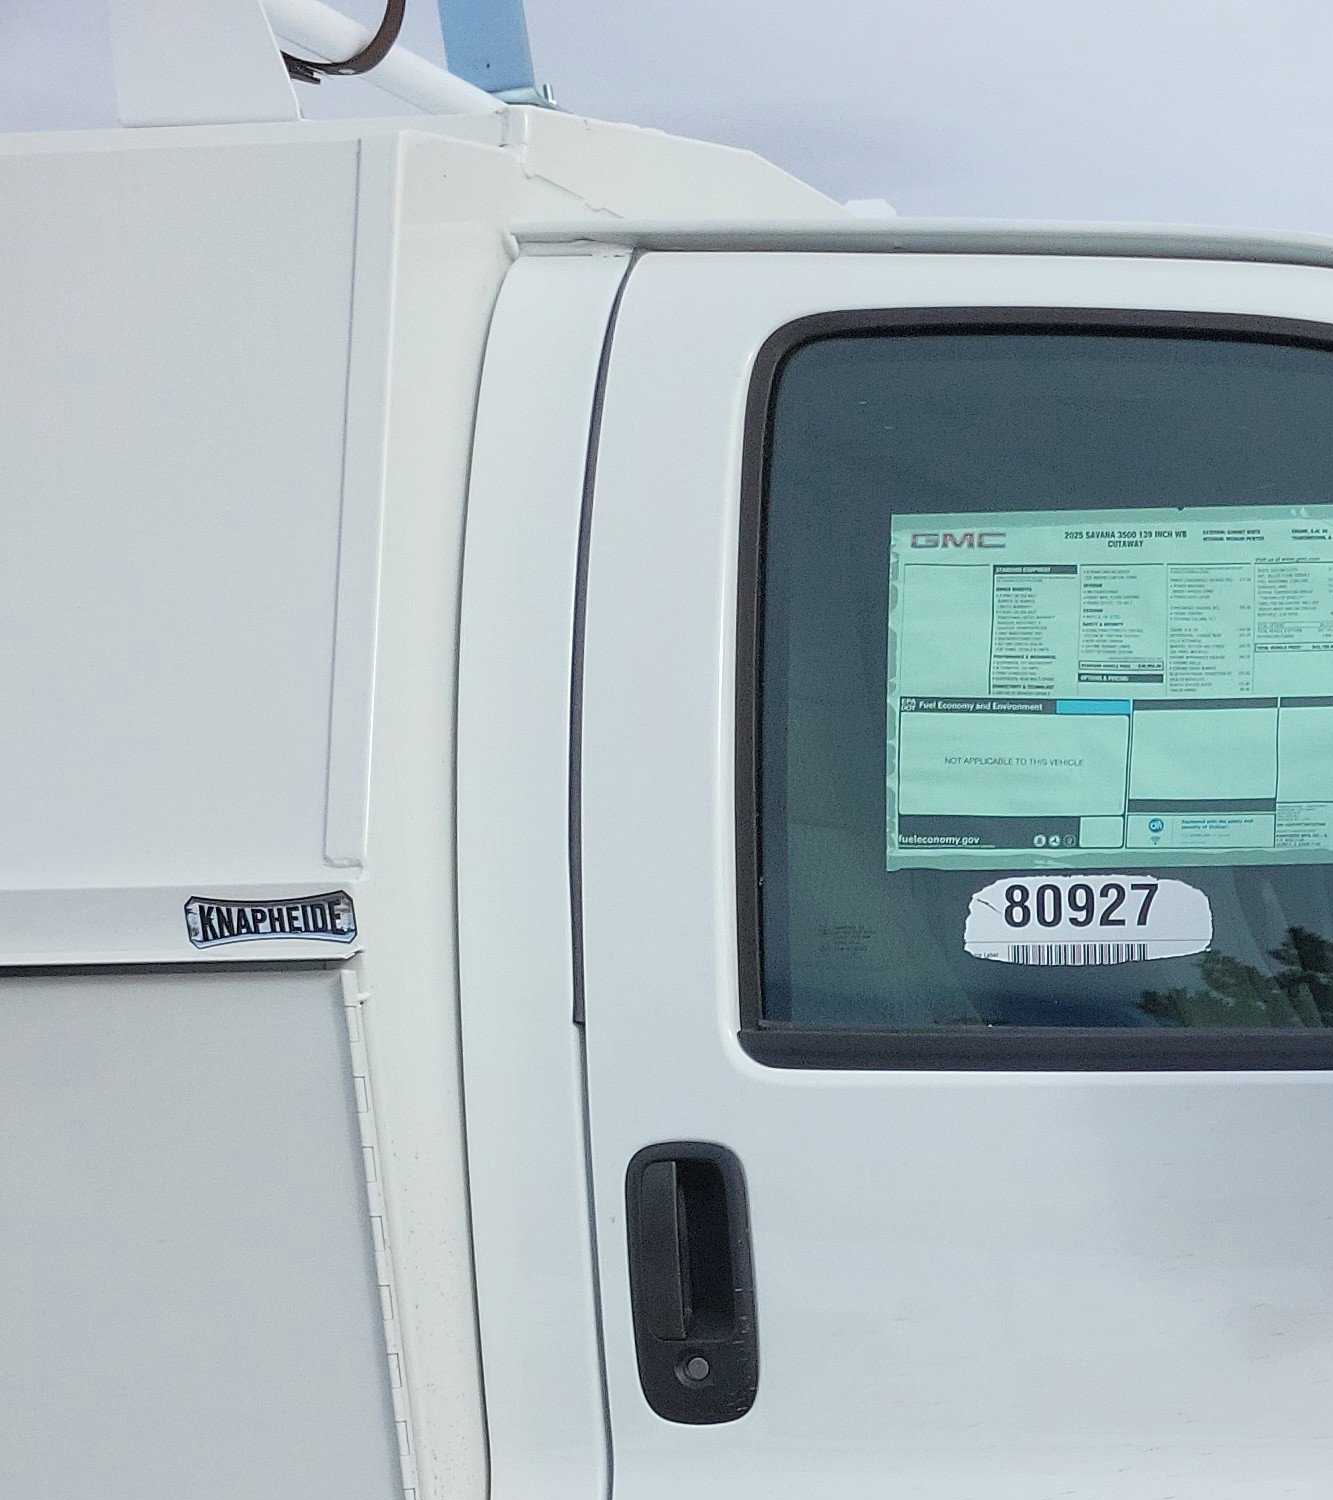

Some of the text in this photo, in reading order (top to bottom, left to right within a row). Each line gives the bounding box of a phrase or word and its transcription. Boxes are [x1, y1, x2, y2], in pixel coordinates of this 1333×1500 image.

[910, 532, 1007, 549] GMC
[919, 701, 937, 710] Fuel
[938, 701, 975, 712] Economy
[993, 702, 1043, 711] Environment
[945, 757, 1084, 767] NOT APPLICABLE TO THIS VEHICLE
[898, 834, 980, 847] fueleconomy.gov
[1003, 882, 1159, 928] 80927
[197, 899, 347, 942] KNAPHEIDE
